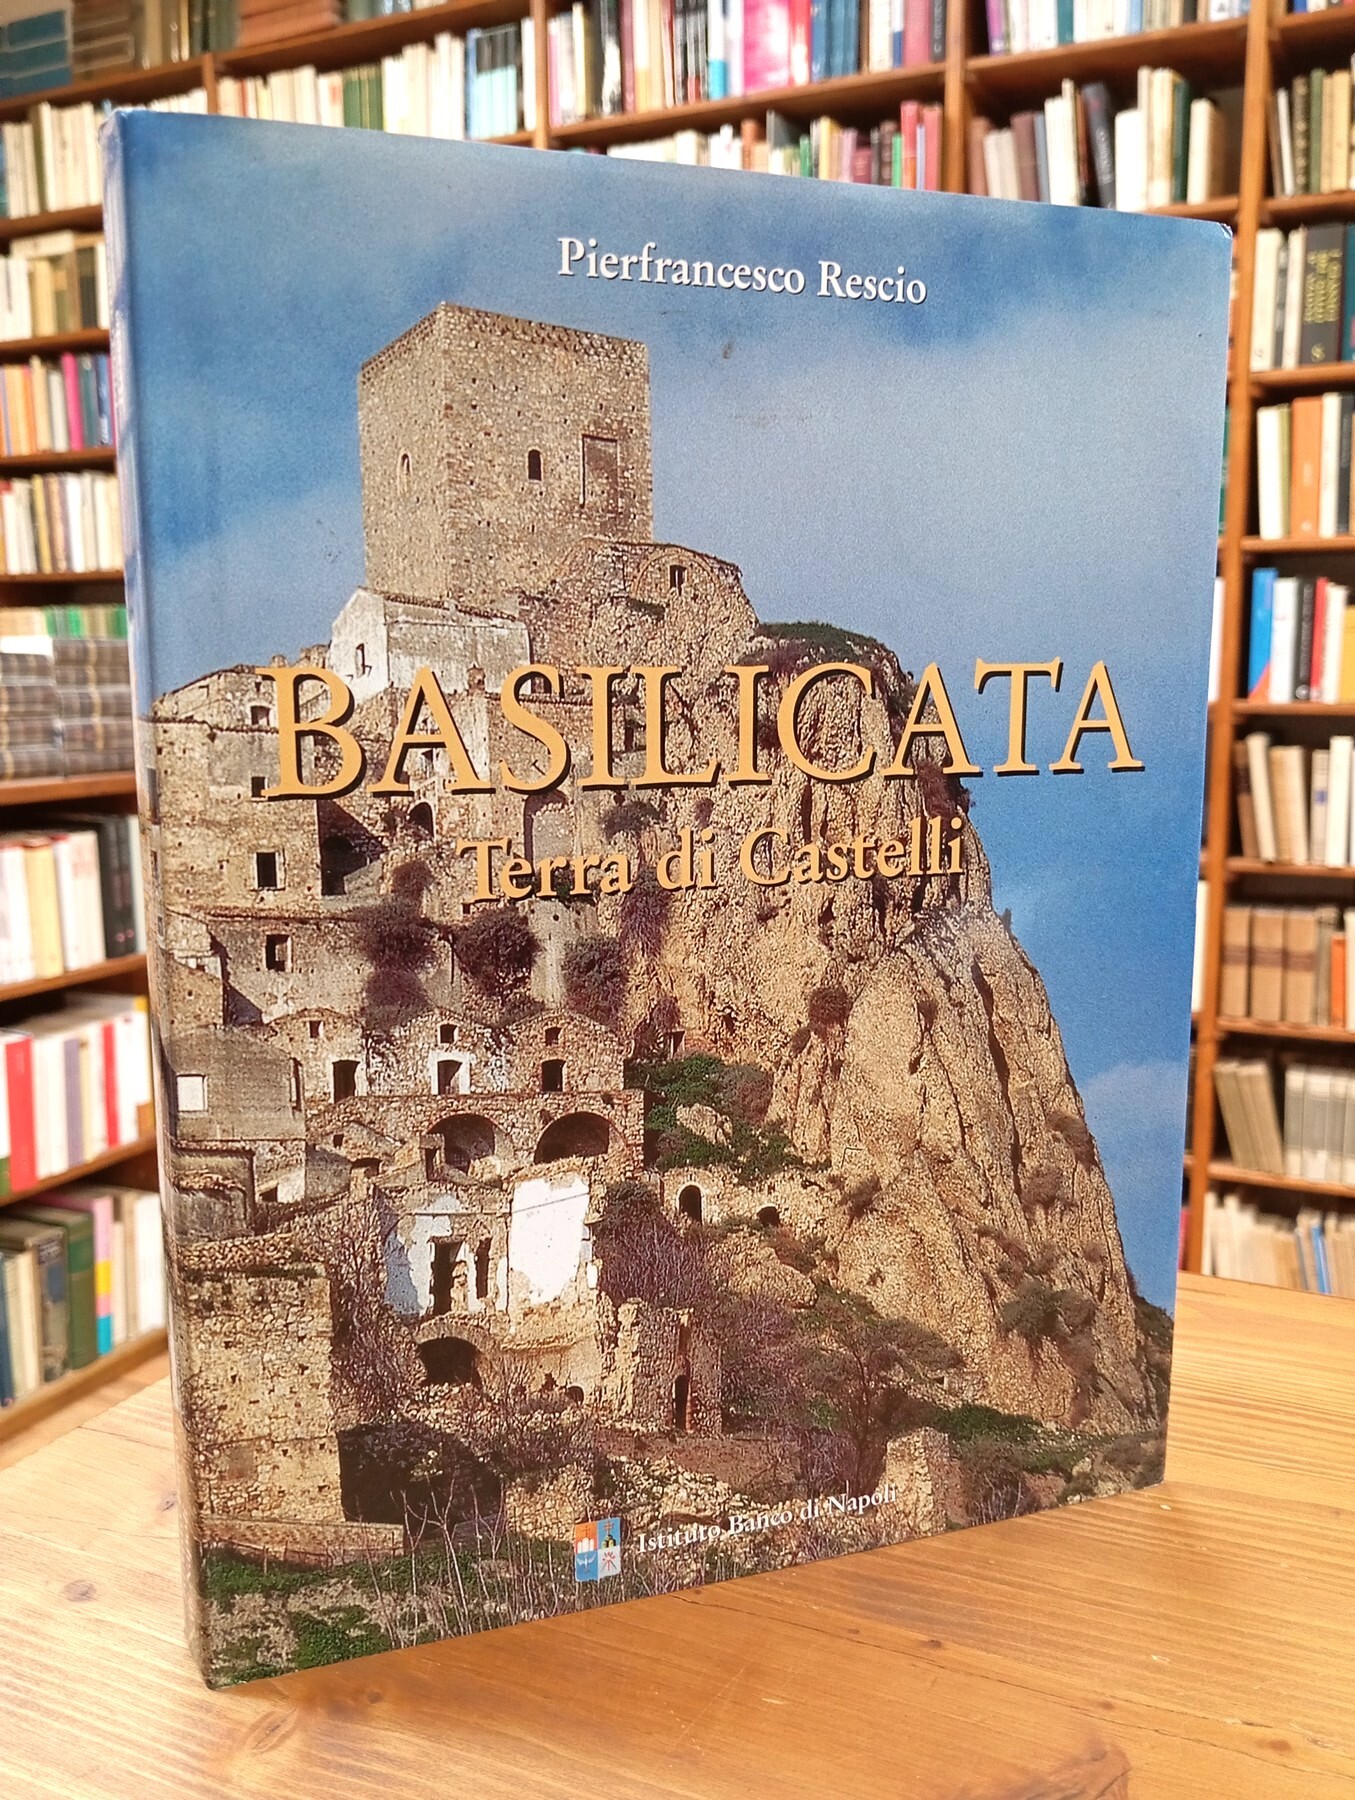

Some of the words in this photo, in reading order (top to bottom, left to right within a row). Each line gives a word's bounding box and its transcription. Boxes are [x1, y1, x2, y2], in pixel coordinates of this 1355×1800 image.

[557, 237, 806, 295] Pierfrancesco
[817, 259, 928, 305] Rescio
[255, 657, 1145, 800] BASILICATA
[456, 836, 634, 904] Terra
[656, 826, 717, 891] di
[739, 815, 966, 887] Castelli
[636, 1523, 721, 1555] Istituto
[727, 1510, 794, 1537] Banco
[799, 1500, 820, 1523] di
[826, 1483, 898, 1518] Napoli
